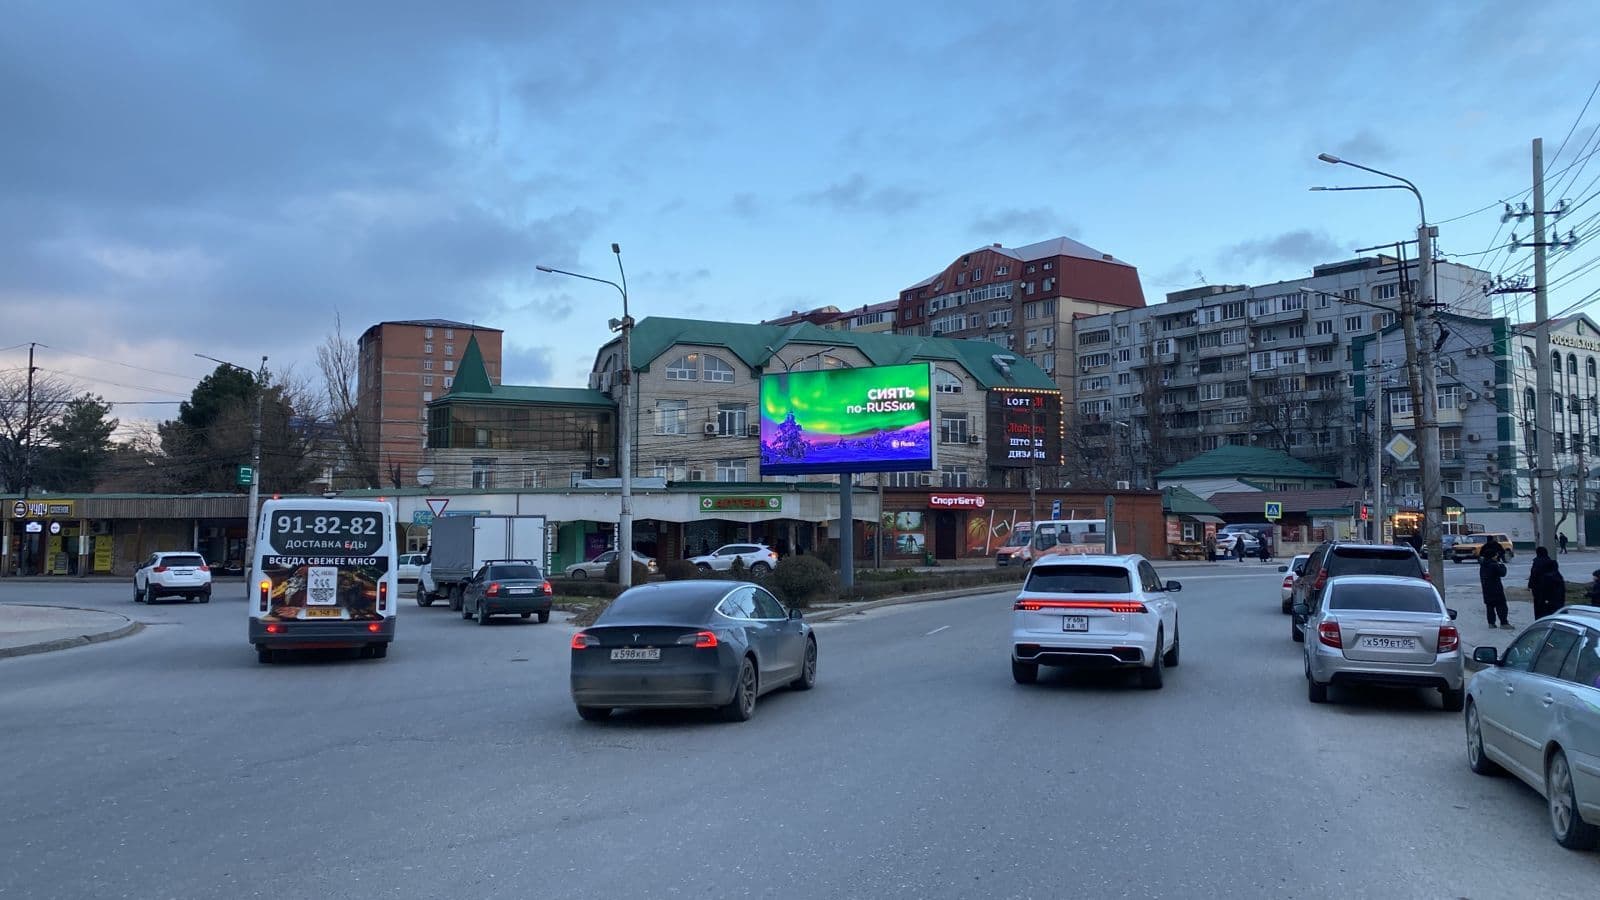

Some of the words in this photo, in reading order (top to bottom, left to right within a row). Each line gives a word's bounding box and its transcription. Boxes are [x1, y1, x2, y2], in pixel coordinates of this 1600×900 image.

[1007, 398, 1030, 406] LOFT
[847, 401, 915, 414] по-RUSSки
[277, 516, 377, 535] 91-82-82
[285, 540, 342, 550] ДОСТАВКА
[344, 540, 367, 550] ЕДЫ
[269, 557, 306, 566] ВСЕГДА
[308, 557, 345, 566] СВЕЖЕЕ
[347, 557, 377, 566] МЯСО
